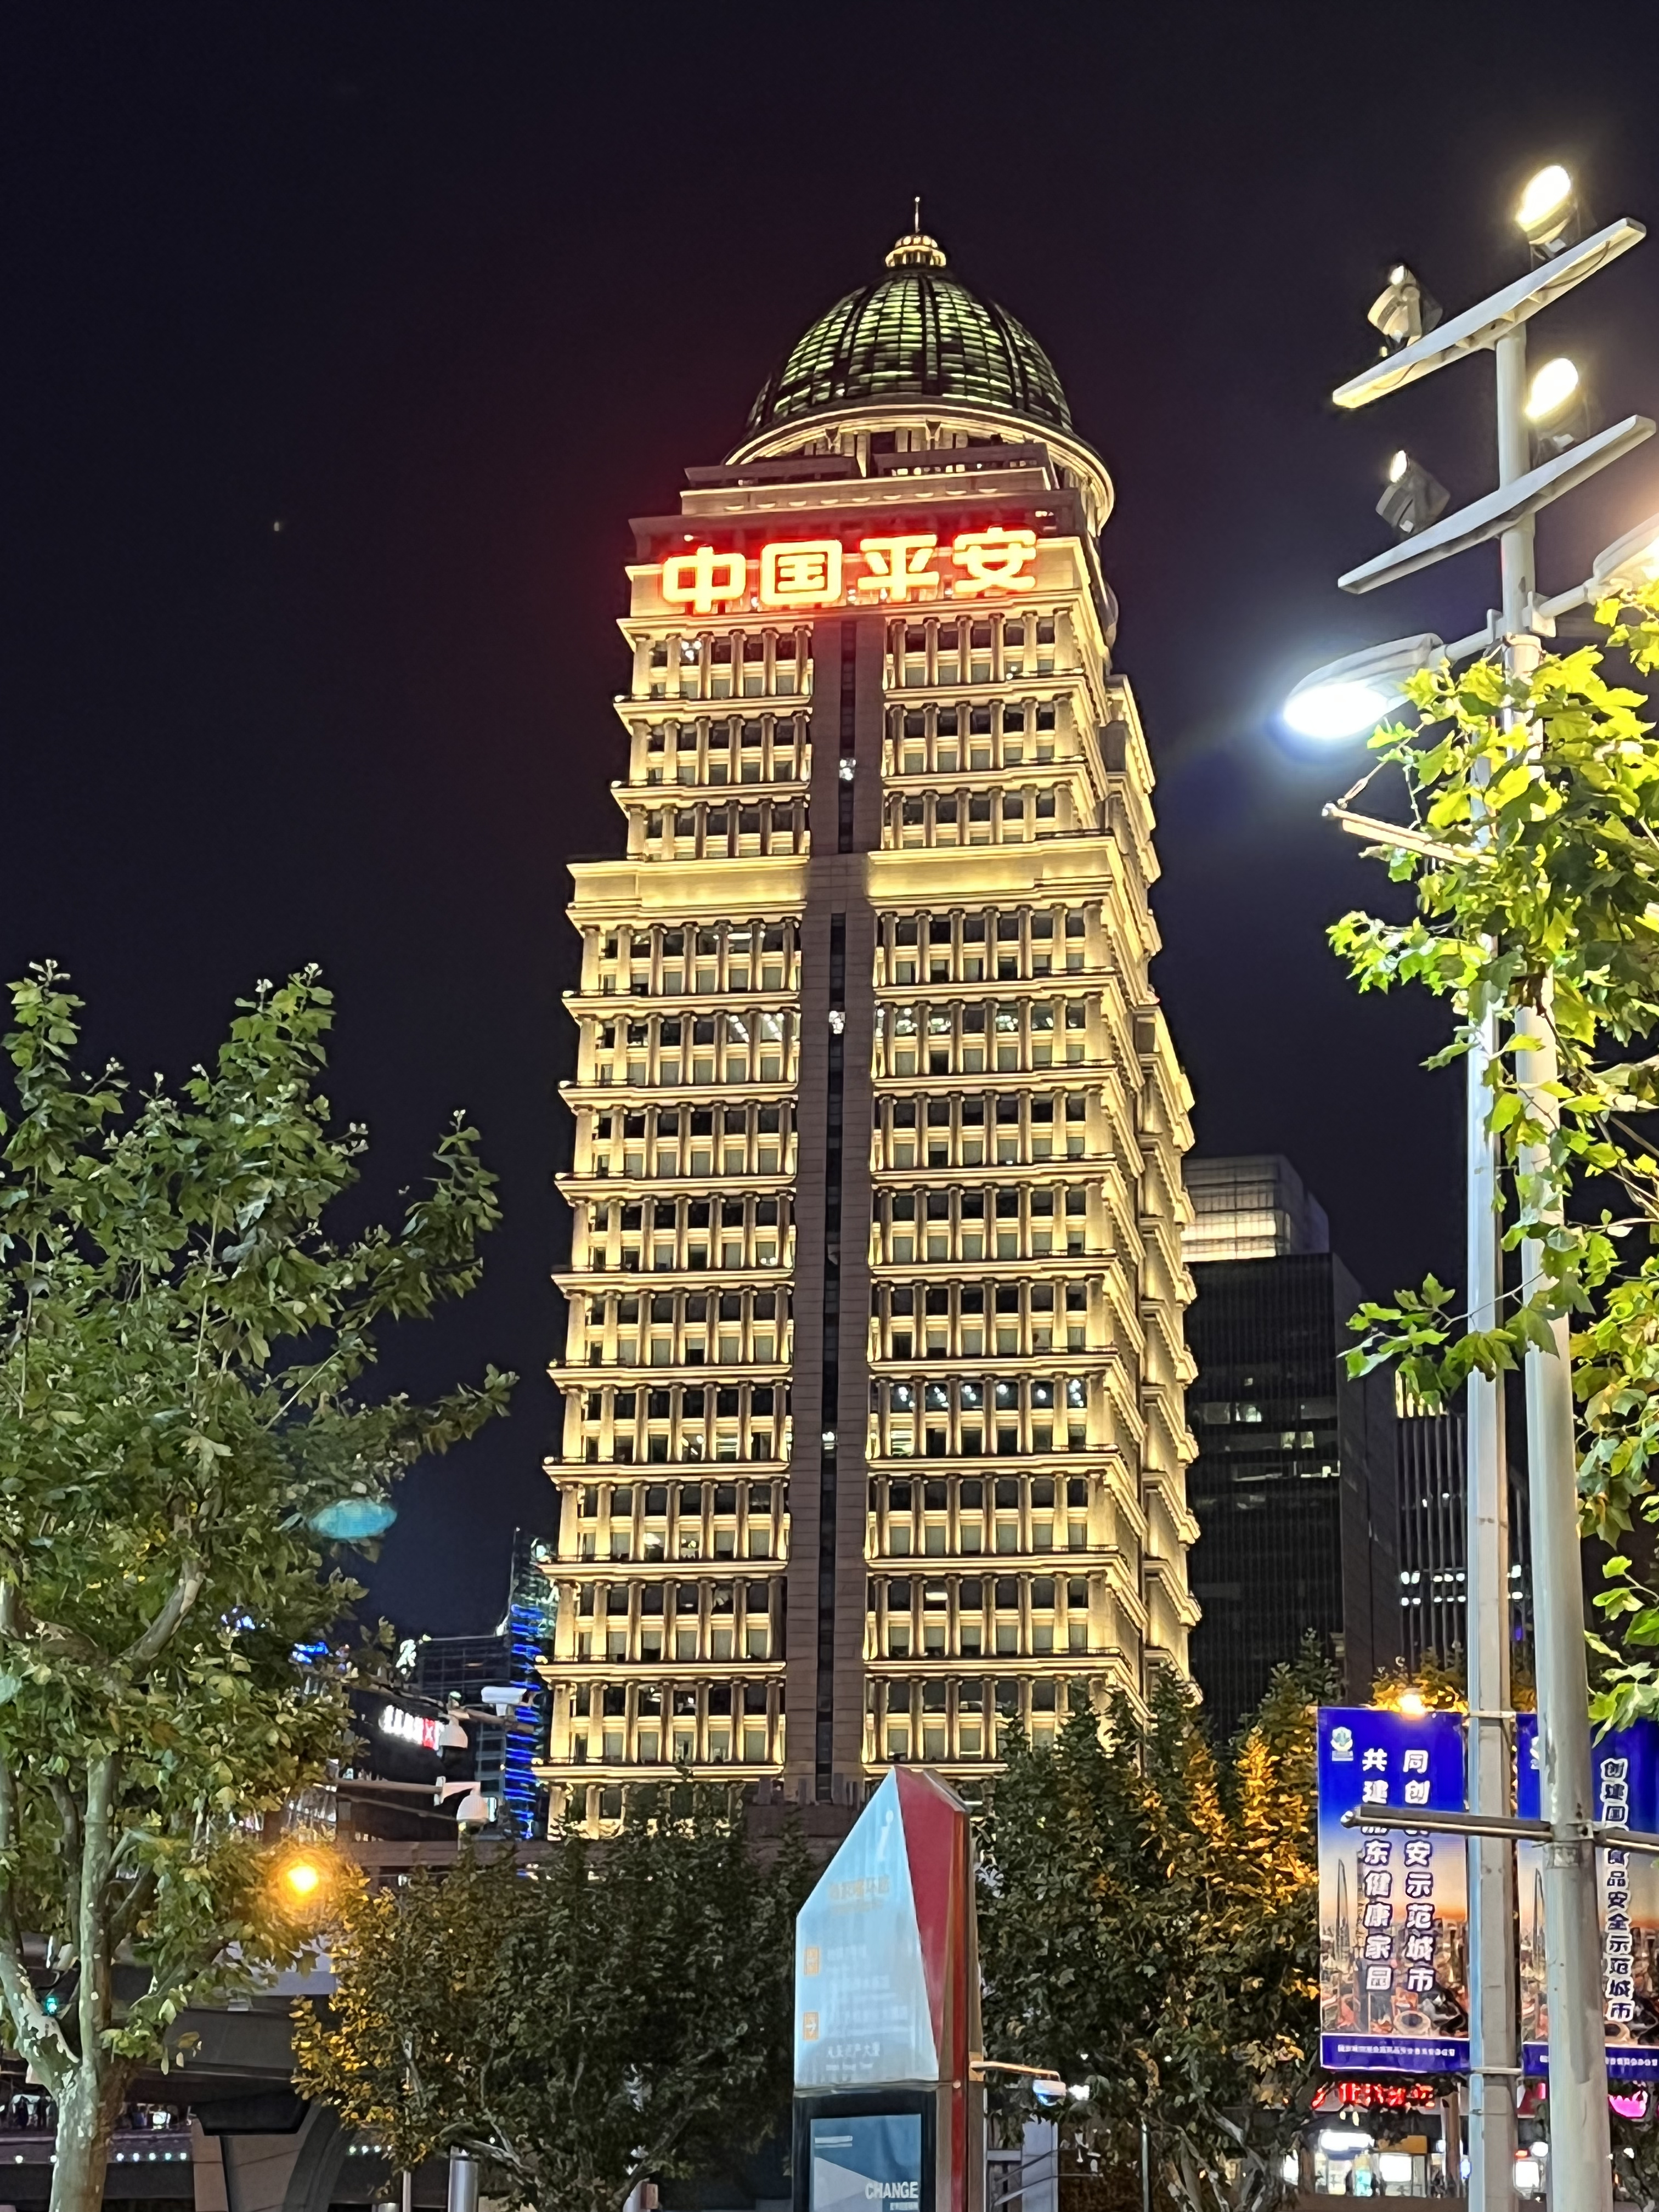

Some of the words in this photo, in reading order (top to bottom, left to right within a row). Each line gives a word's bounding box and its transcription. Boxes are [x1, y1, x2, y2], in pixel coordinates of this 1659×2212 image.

[662, 527, 1037, 613] 中国平安
[1403, 1749, 1435, 1992] 同创安示范城市
[1601, 1759, 1634, 2021] 创建国食品安全示范城市
[865, 2181, 919, 2199] CHANGE
